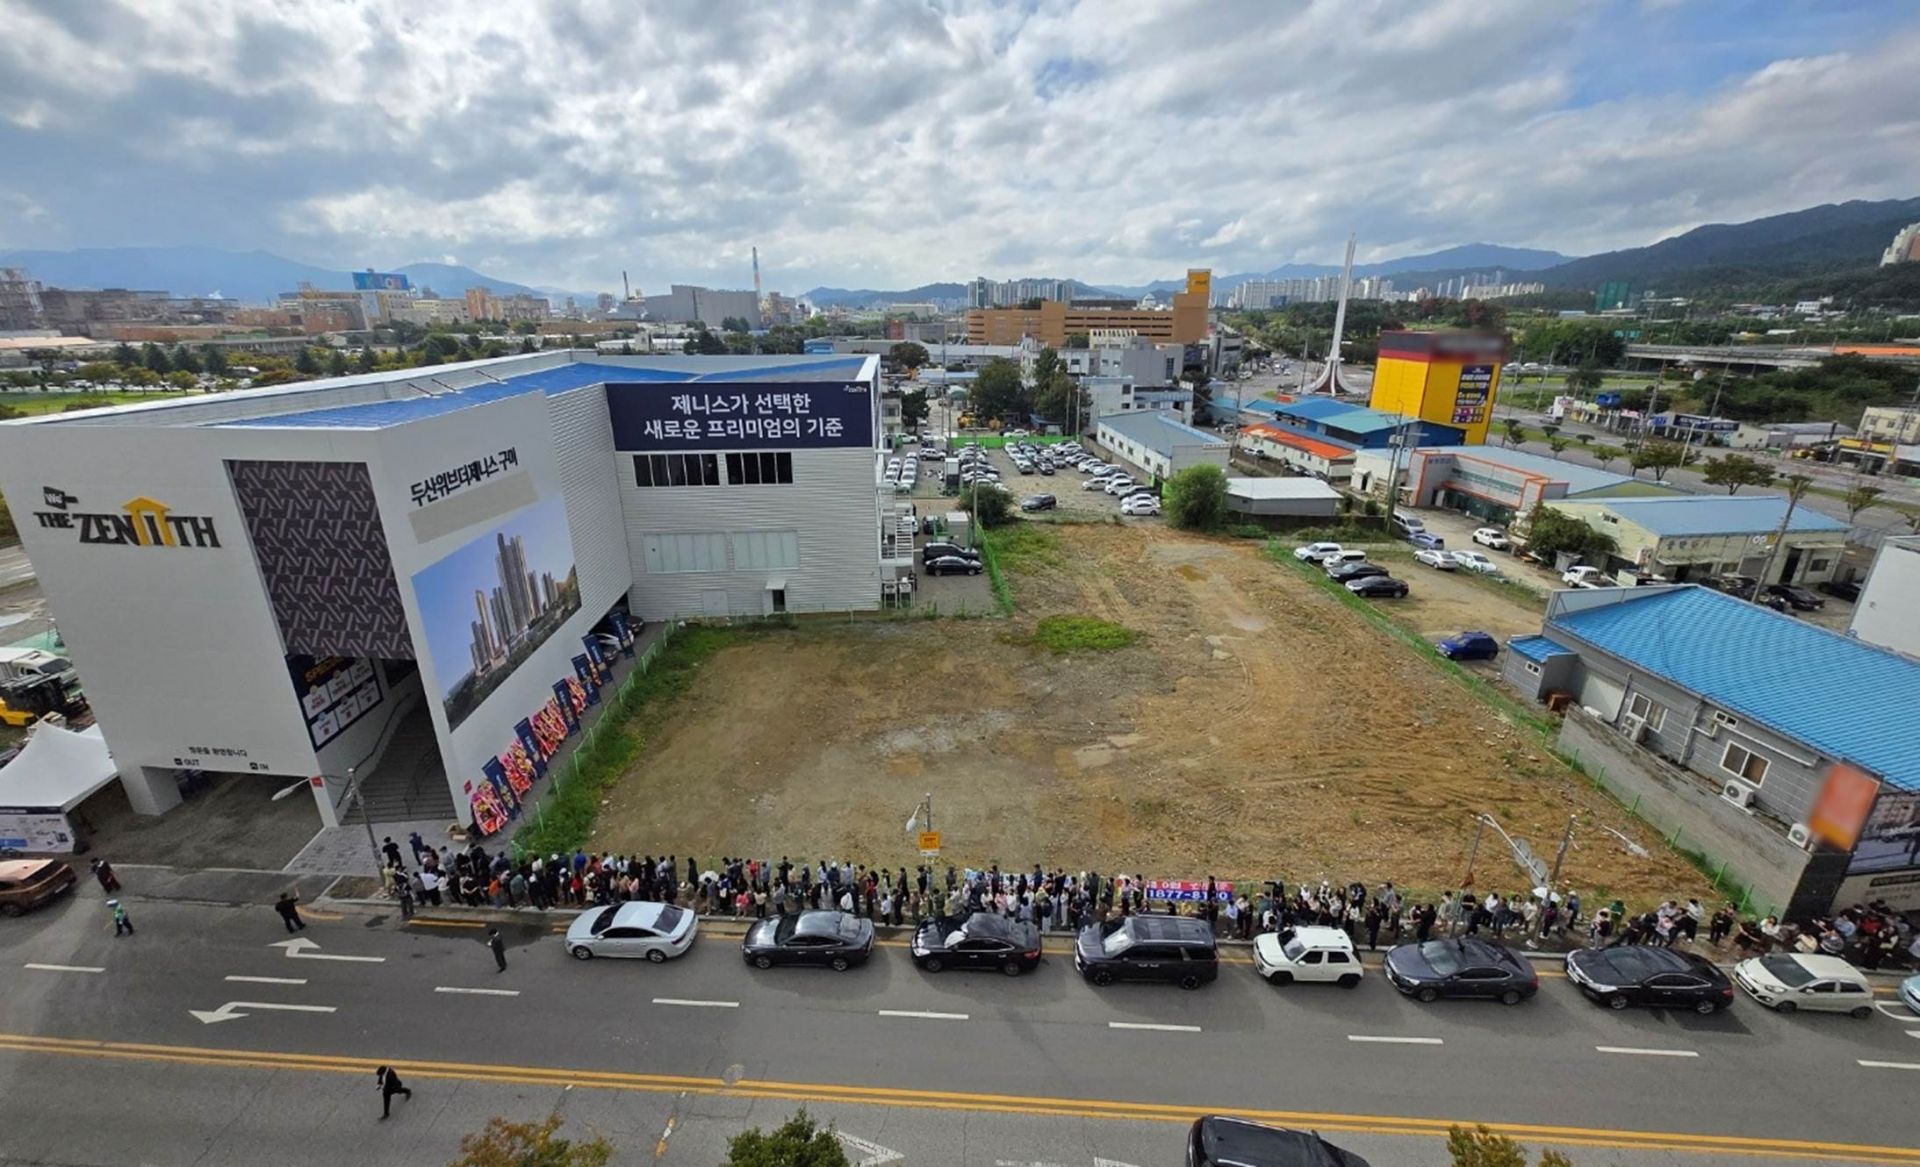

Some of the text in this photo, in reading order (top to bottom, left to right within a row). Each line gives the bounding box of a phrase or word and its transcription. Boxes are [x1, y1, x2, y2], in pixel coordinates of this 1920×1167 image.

[671, 393, 811, 415] 제니스가 선택한
[643, 417, 844, 440] 새로운 프리미엄의 기준
[410, 446, 519, 507] 두산위브더제니스 구미
[33, 505, 222, 548] THE ZENITH
[183, 758, 200, 767] OUT
[1148, 888, 1229, 900] 1877-810
